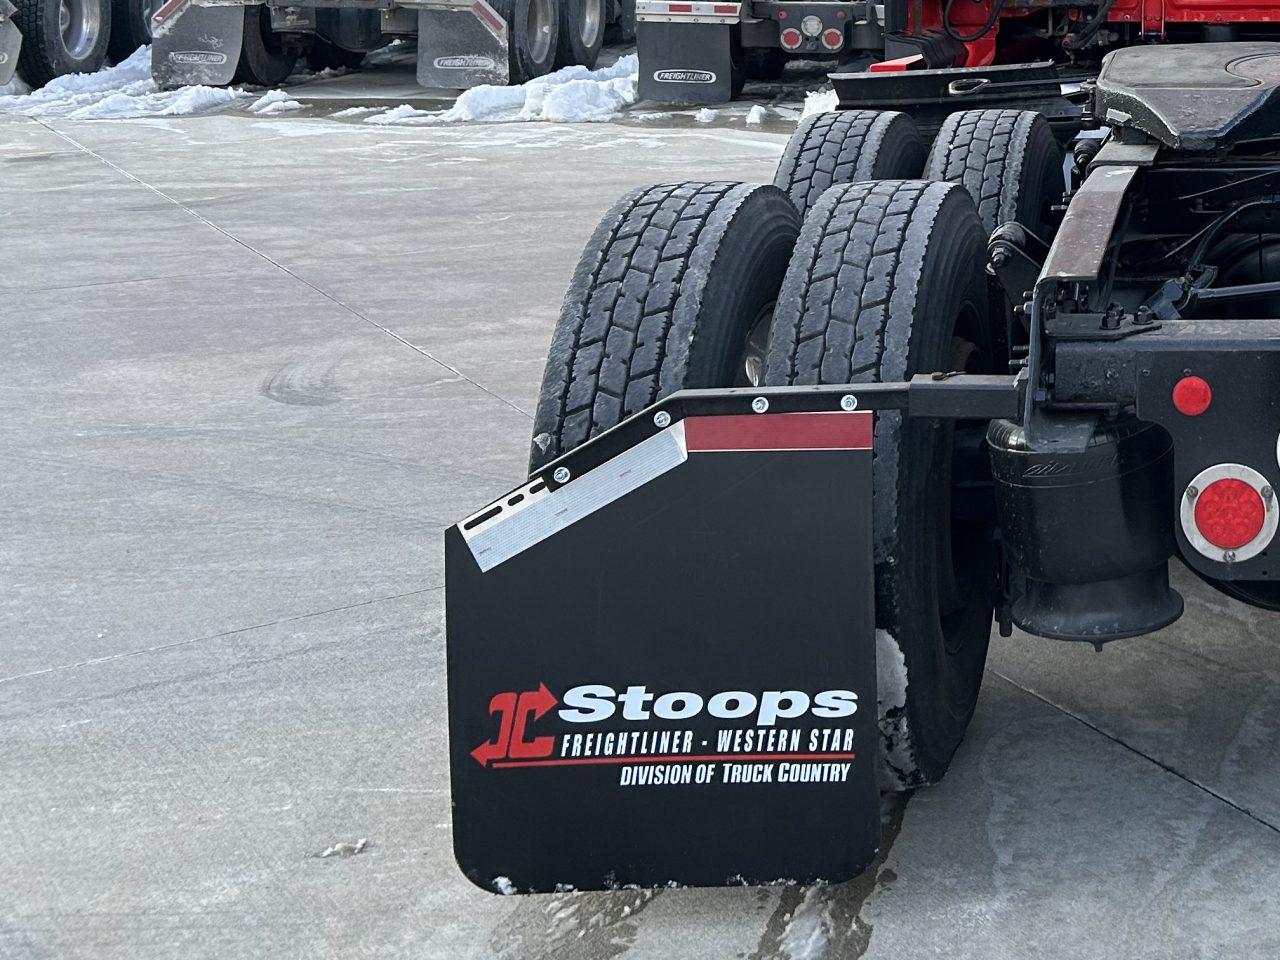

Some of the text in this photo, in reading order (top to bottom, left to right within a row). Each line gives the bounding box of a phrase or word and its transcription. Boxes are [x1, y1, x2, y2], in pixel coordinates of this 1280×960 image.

[660, 72, 711, 81] FREIGHTLINER
[558, 684, 859, 727] Stoops
[561, 730, 694, 758] FREIGHTLINER
[717, 729, 800, 752] WESTERN
[808, 728, 854, 752] STAR
[619, 762, 851, 786] DIVISION OF TRUCK COUNTRY
